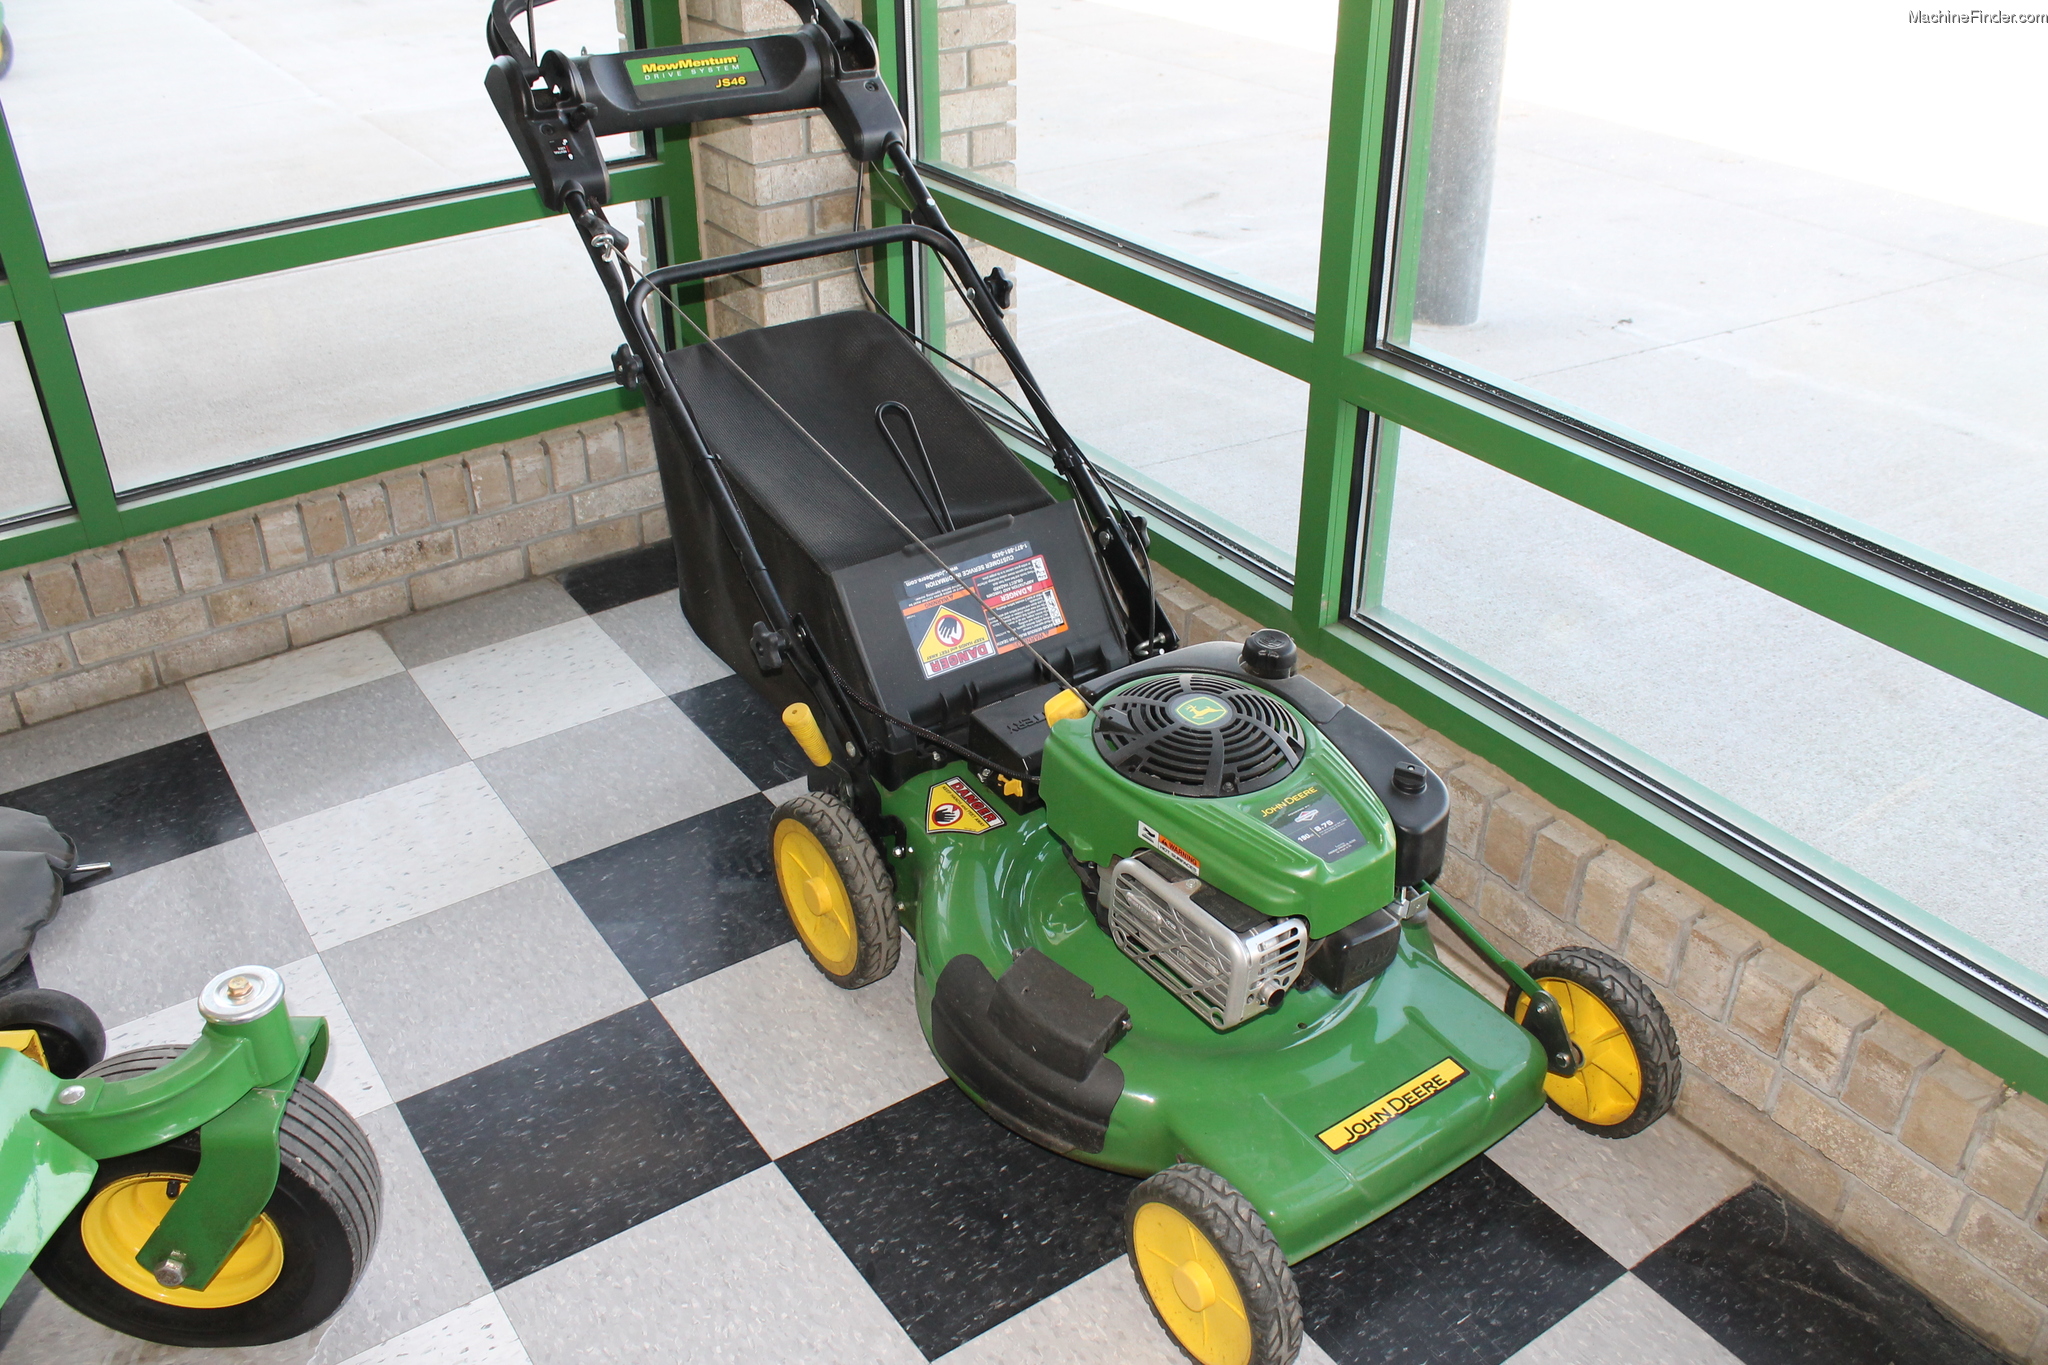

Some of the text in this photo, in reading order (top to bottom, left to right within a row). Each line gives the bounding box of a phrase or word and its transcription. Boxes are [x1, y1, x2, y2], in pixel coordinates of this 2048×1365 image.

[641, 55, 738, 73] MowMentum
[644, 64, 740, 81] DRIVE SYSTEM
[715, 76, 747, 88] JS46
[961, 564, 985, 576] SERVICE
[984, 554, 1014, 568] CUSTOMER
[999, 587, 1027, 601] DANGER
[929, 643, 988, 672] DANGER
[950, 782, 997, 822] DANGER
[1261, 801, 1287, 817] JOHN
[1283, 787, 1318, 805] DEERE
[1169, 843, 1197, 866] WARNING
[1344, 1074, 1447, 1142] JOHN DEERE
